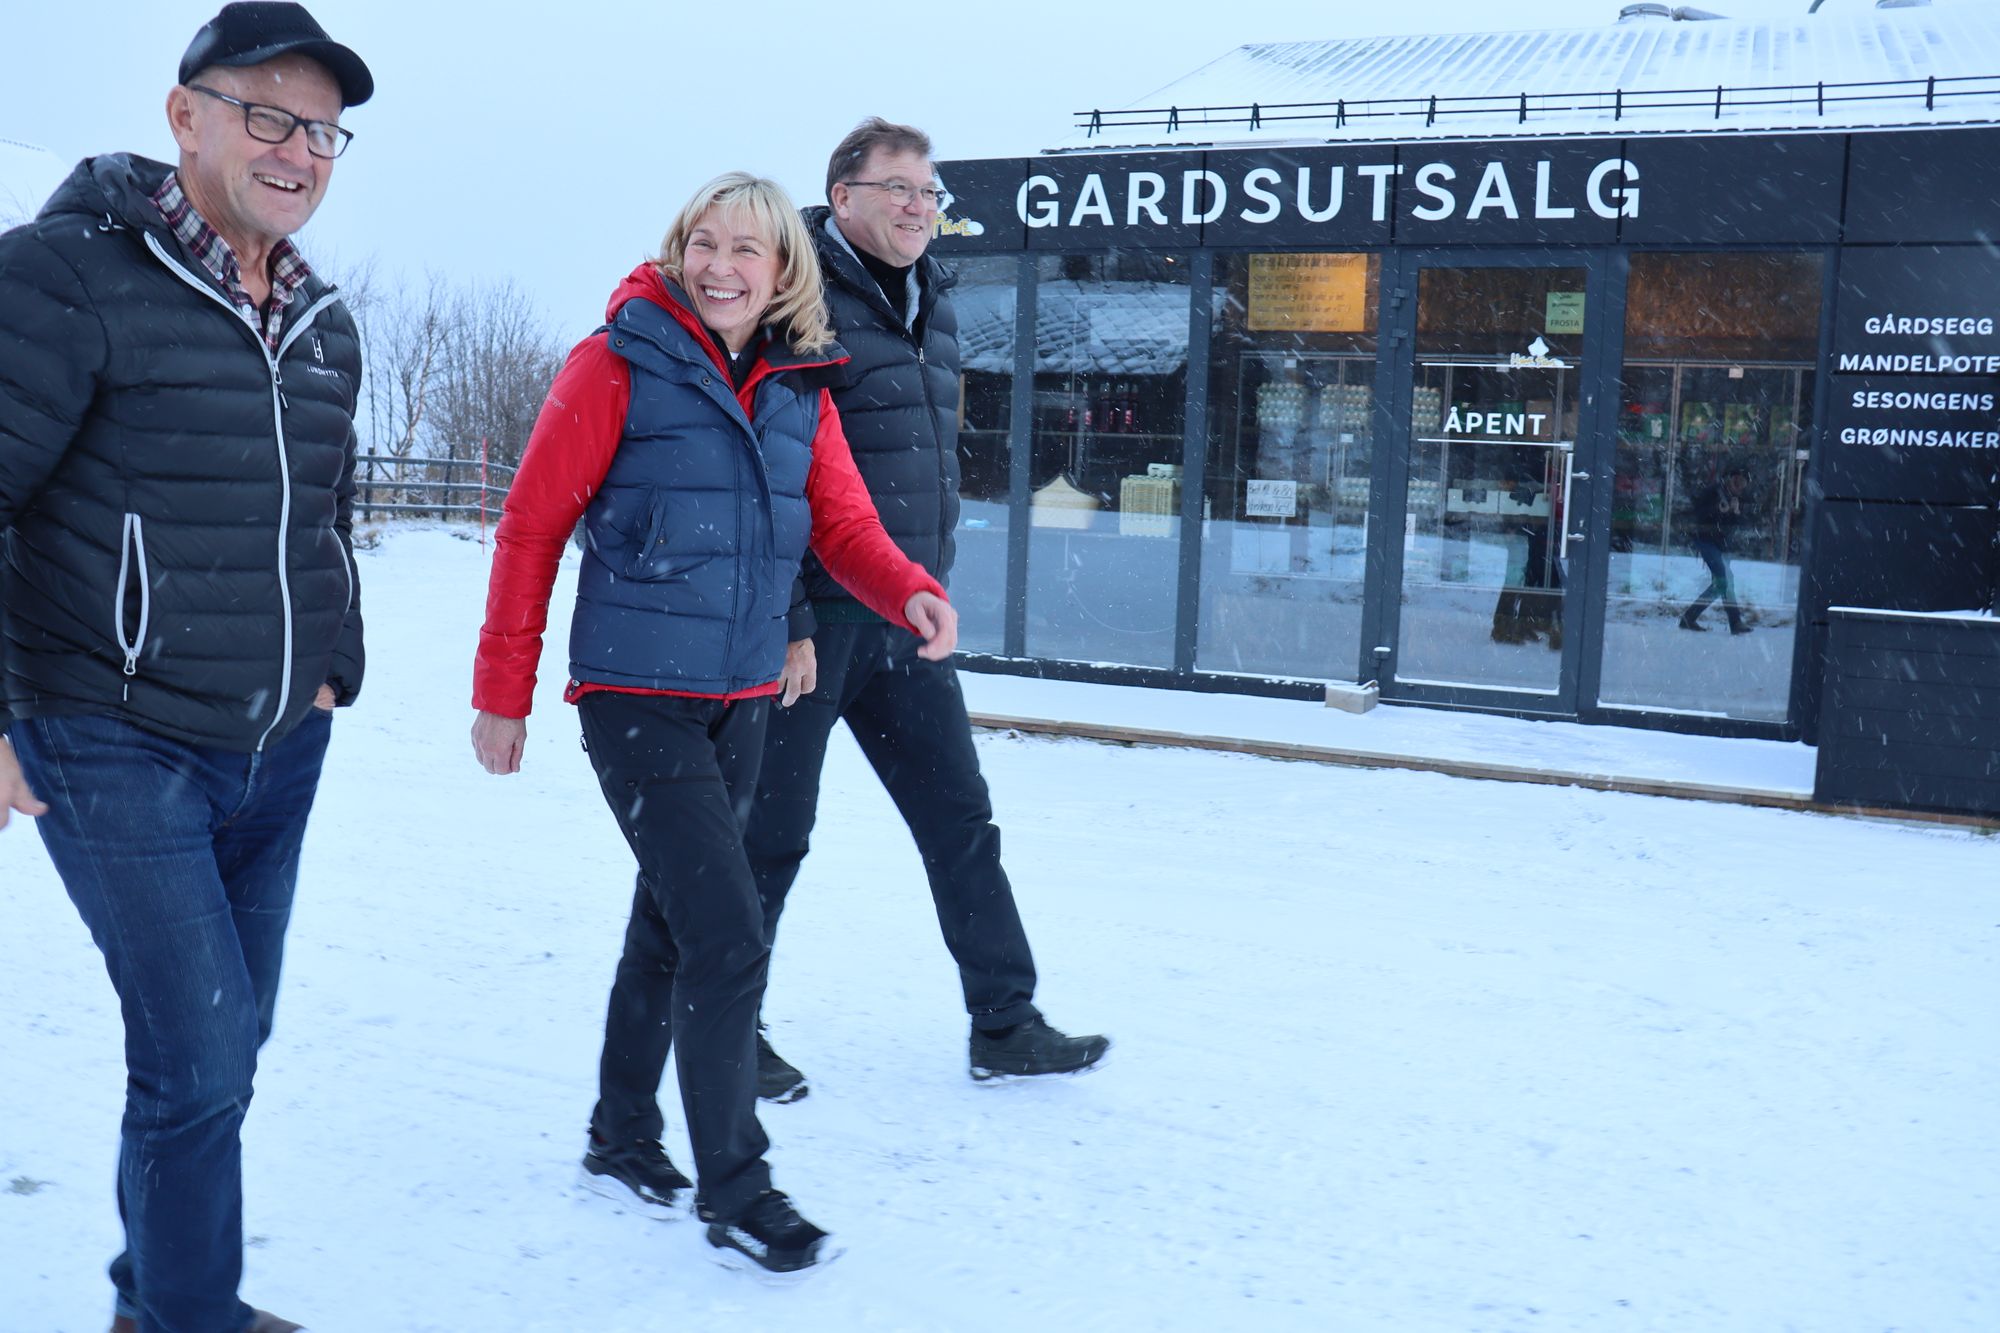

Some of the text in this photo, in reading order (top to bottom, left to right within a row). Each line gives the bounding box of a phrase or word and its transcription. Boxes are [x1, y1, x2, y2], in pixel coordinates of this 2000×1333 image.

[1016, 158, 1641, 229] GARDSUTSALG
[1550, 319, 1580, 327] FROSTA
[1864, 313, 1994, 336] GÅRDSEGG
[1852, 391, 1994, 411] SESONGENS
[1443, 406, 1547, 436] ÅPENT
[1840, 427, 2000, 449] GRØNNSAKER
